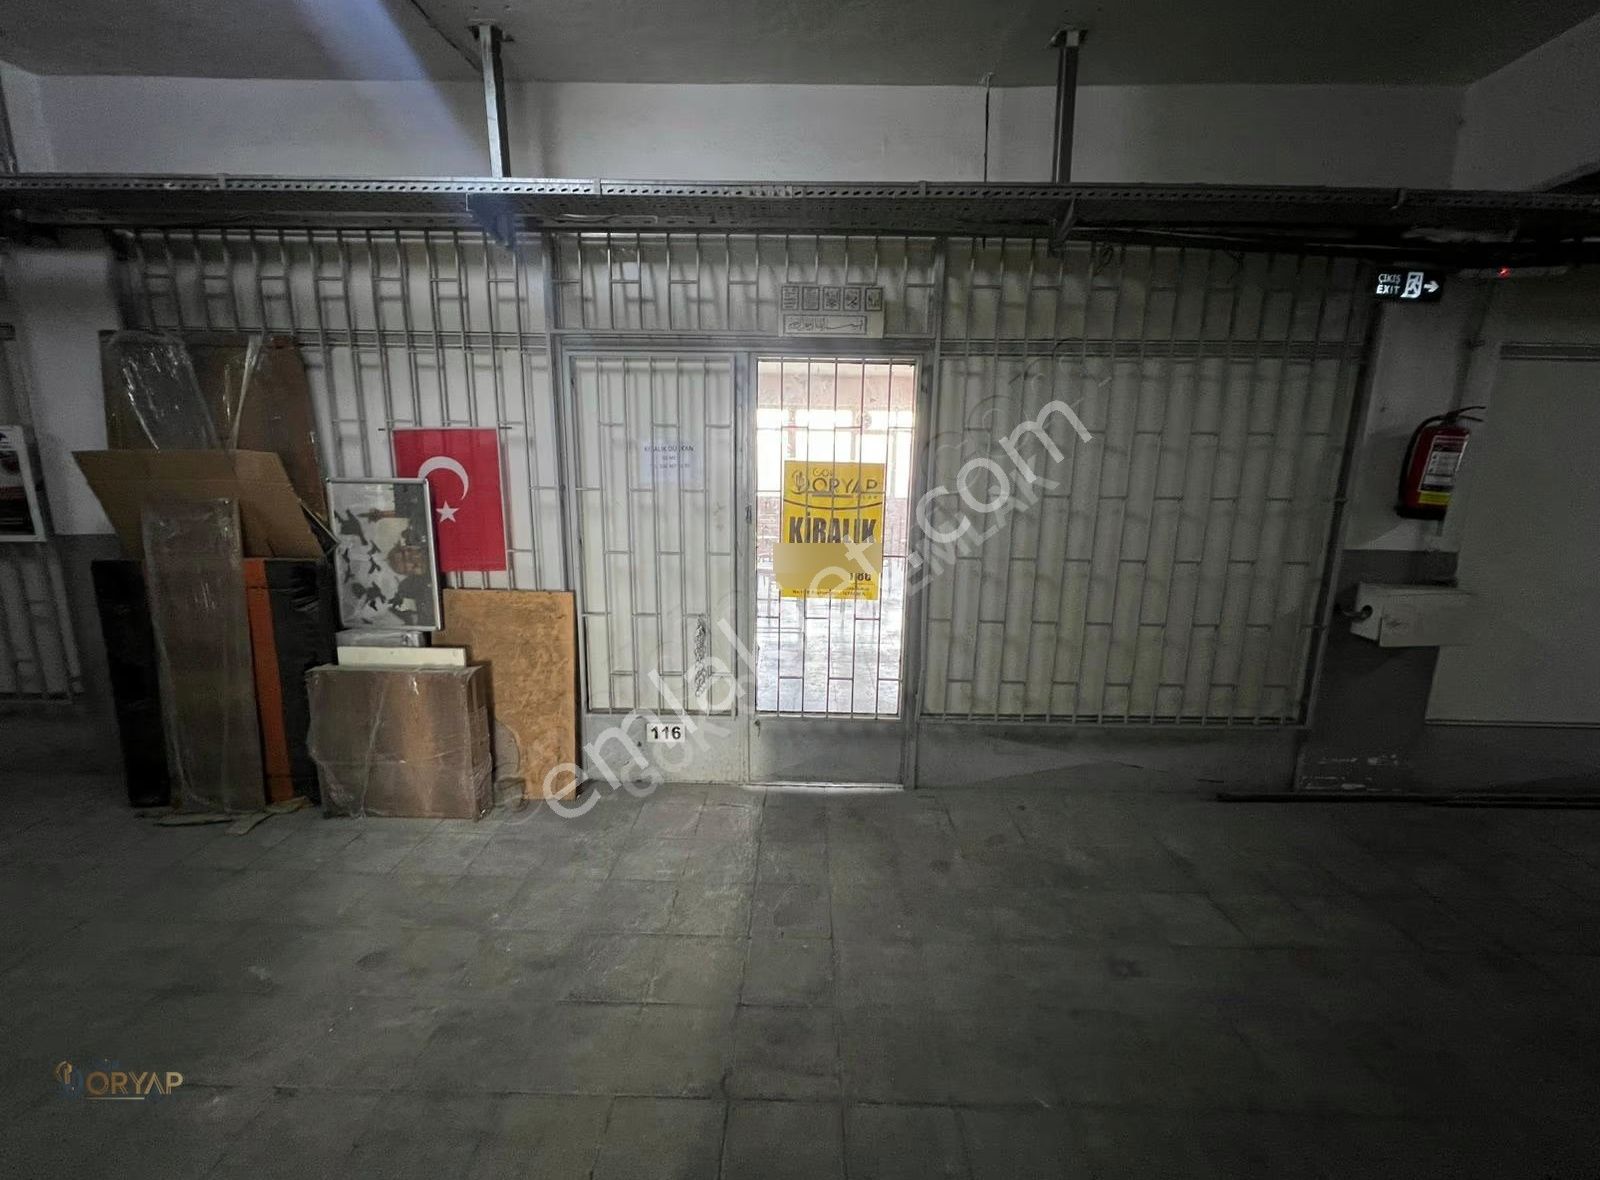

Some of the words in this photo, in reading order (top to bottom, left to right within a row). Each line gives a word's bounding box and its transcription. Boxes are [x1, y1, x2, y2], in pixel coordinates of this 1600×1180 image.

[1376, 284, 1400, 295] EXIT
[789, 512, 877, 544] KİRALIK
[651, 726, 681, 740] 116
